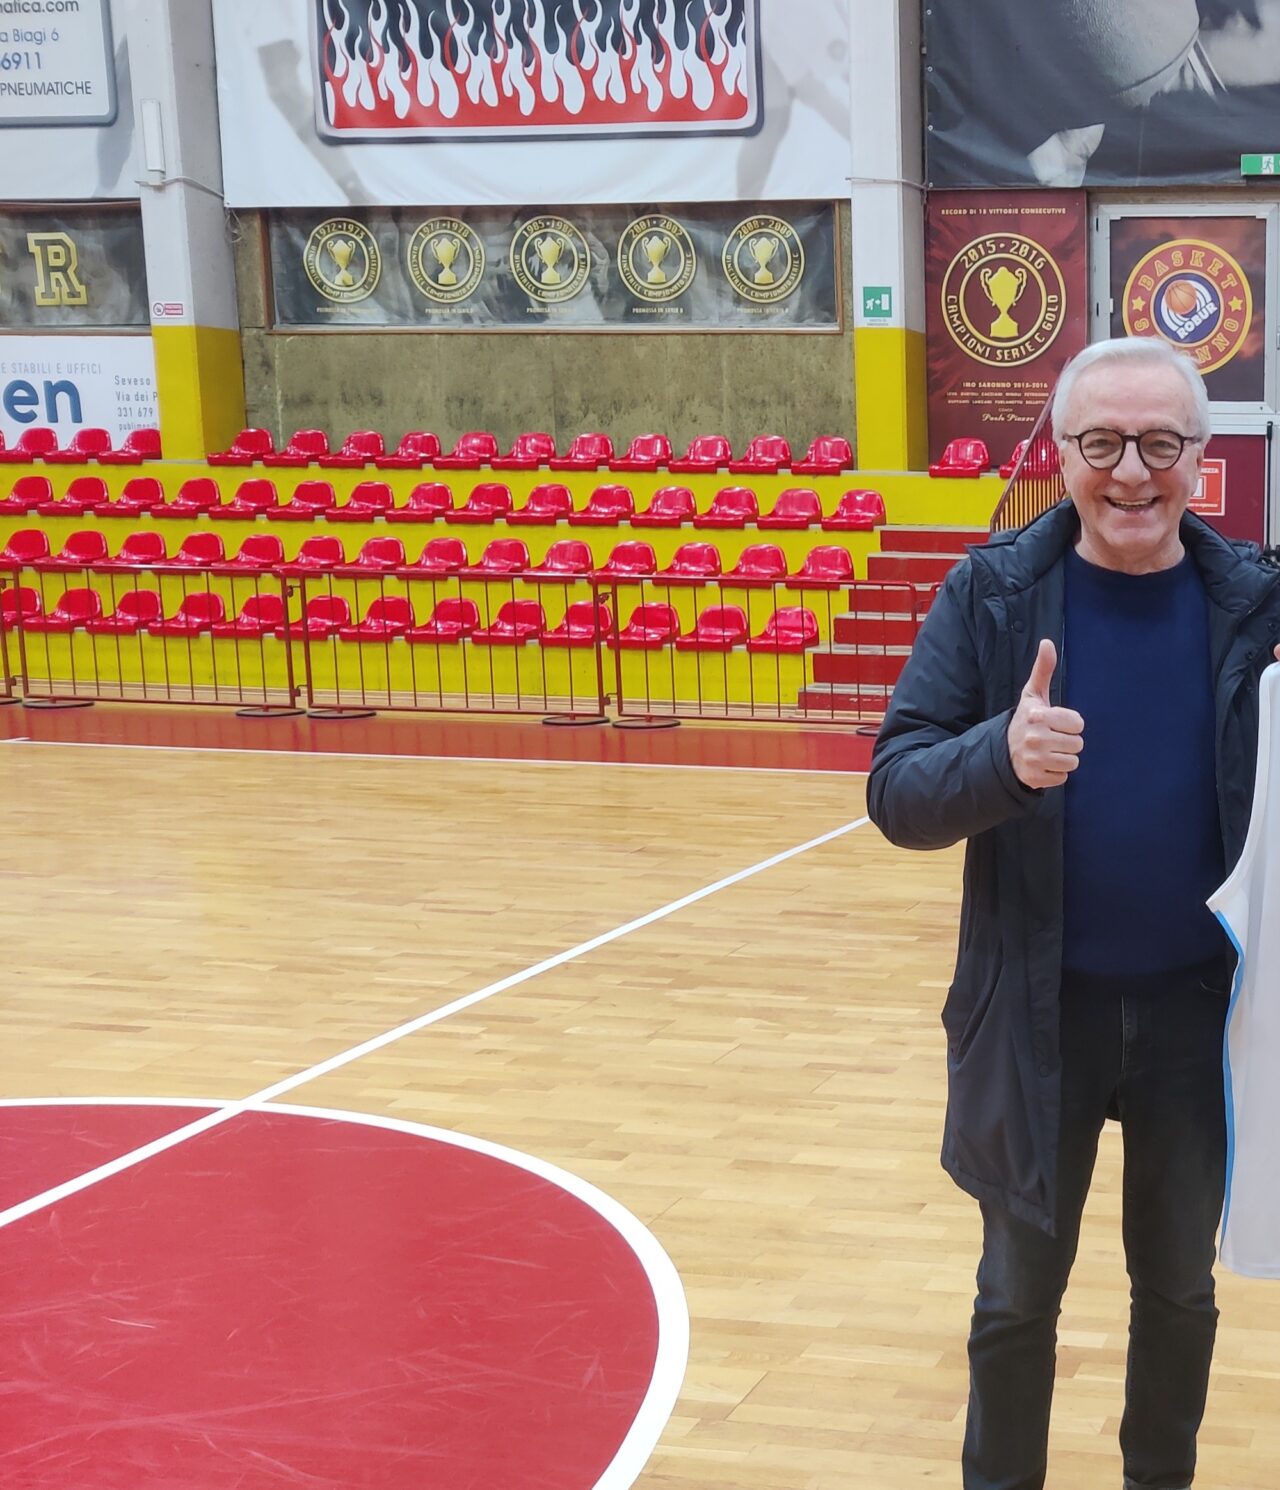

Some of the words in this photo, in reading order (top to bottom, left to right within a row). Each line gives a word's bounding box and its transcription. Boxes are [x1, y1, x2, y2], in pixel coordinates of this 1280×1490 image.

[12, 28, 46, 45] Biagi
[51, 27, 60, 41] 6
[0, 81, 92, 96] PNEUMATICHE
[1021, 207, 1066, 215] CONSECUTIVE
[960, 240, 996, 269] 2015
[1009, 240, 1047, 271] 2016
[27, 232, 88, 306] R
[1138, 249, 1238, 291] BASKET
[947, 295, 991, 358] CAMPIONI
[996, 340, 1036, 361] SERIE
[1034, 332, 1046, 344] C
[1041, 294, 1059, 331] GOLD
[1176, 301, 1218, 340] ROBUR
[11, 362, 51, 374] STABILI
[66, 362, 102, 375] UFFICI
[114, 375, 151, 386] Seveso
[115, 391, 131, 402] Via
[134, 391, 149, 402] dei
[117, 406, 133, 418] 331
